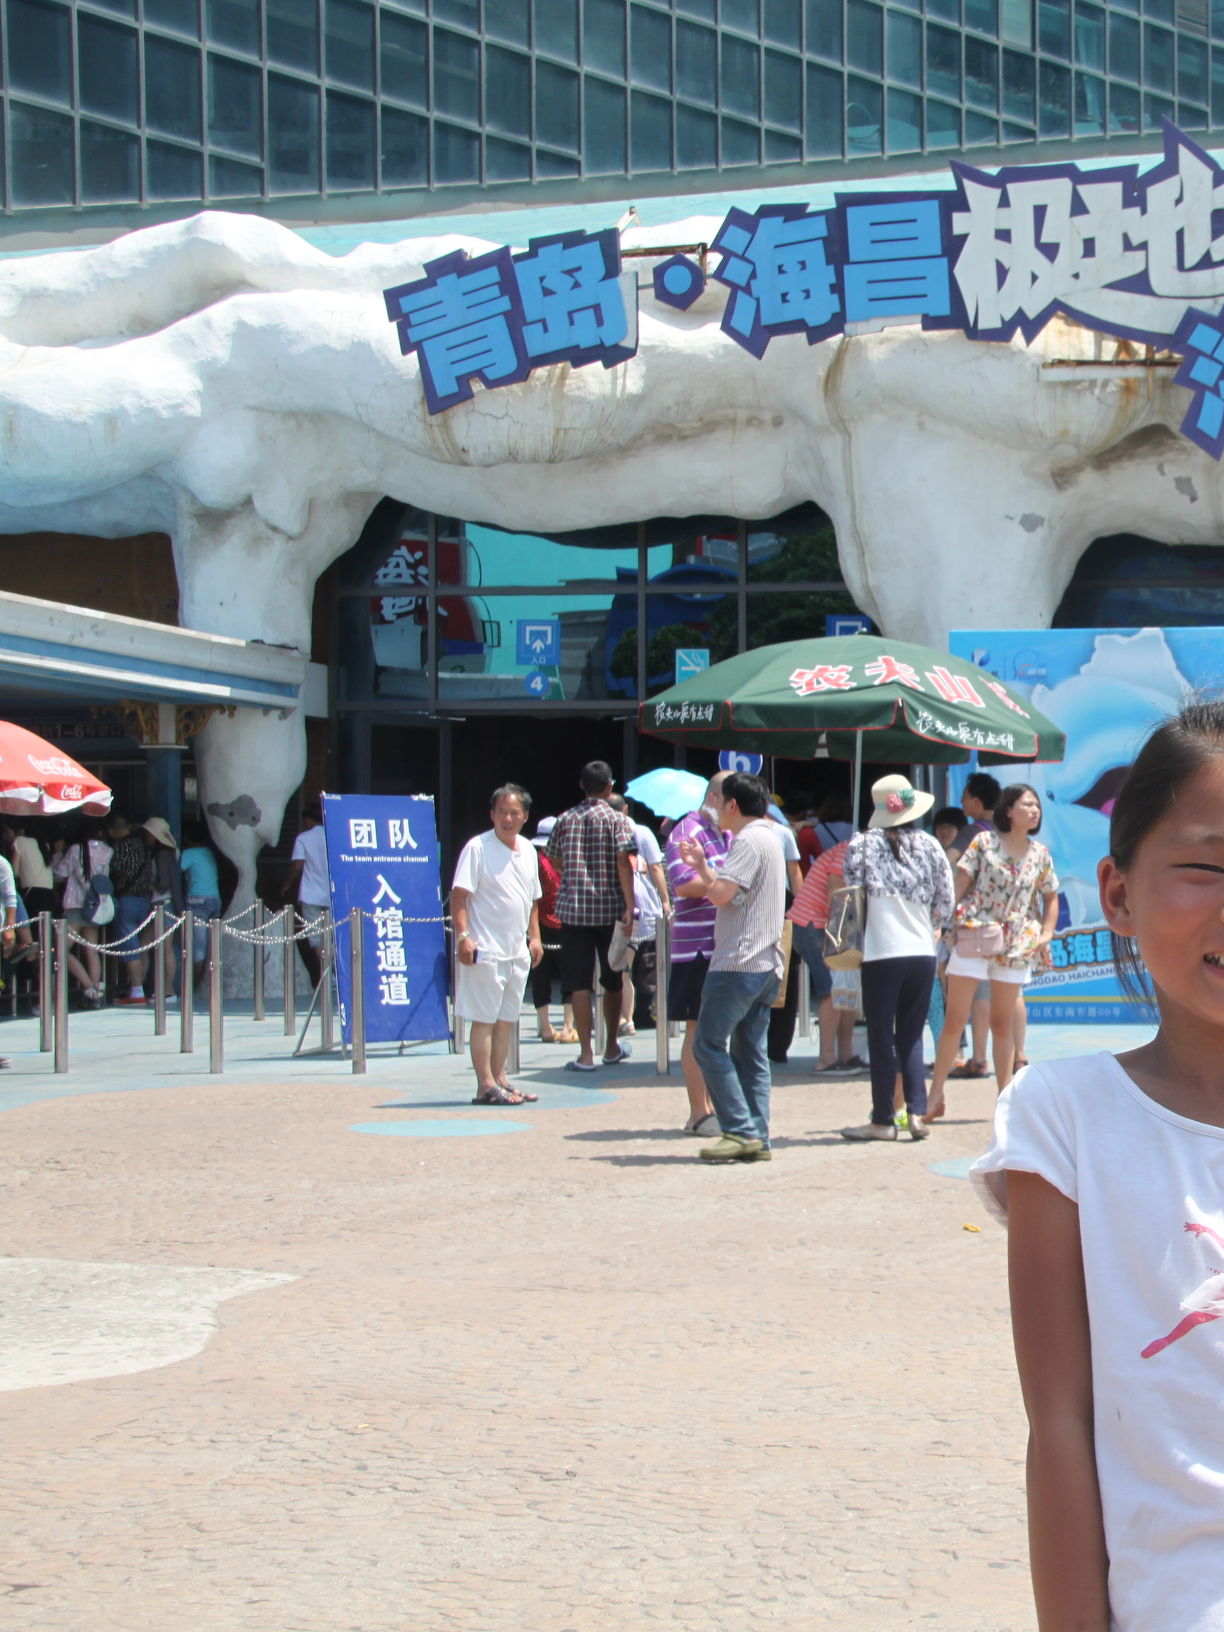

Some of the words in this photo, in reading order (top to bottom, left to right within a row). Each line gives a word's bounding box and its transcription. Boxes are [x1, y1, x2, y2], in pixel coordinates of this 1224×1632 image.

[530, 676, 544, 692] 4
[728, 751, 750, 769] 6
[349, 818, 418, 850] 团队
[341, 854, 353, 863] The
[354, 855, 372, 863] team
[373, 855, 402, 863] entrance
[403, 855, 429, 863] channel
[371, 873, 411, 1006] 入馆通道
